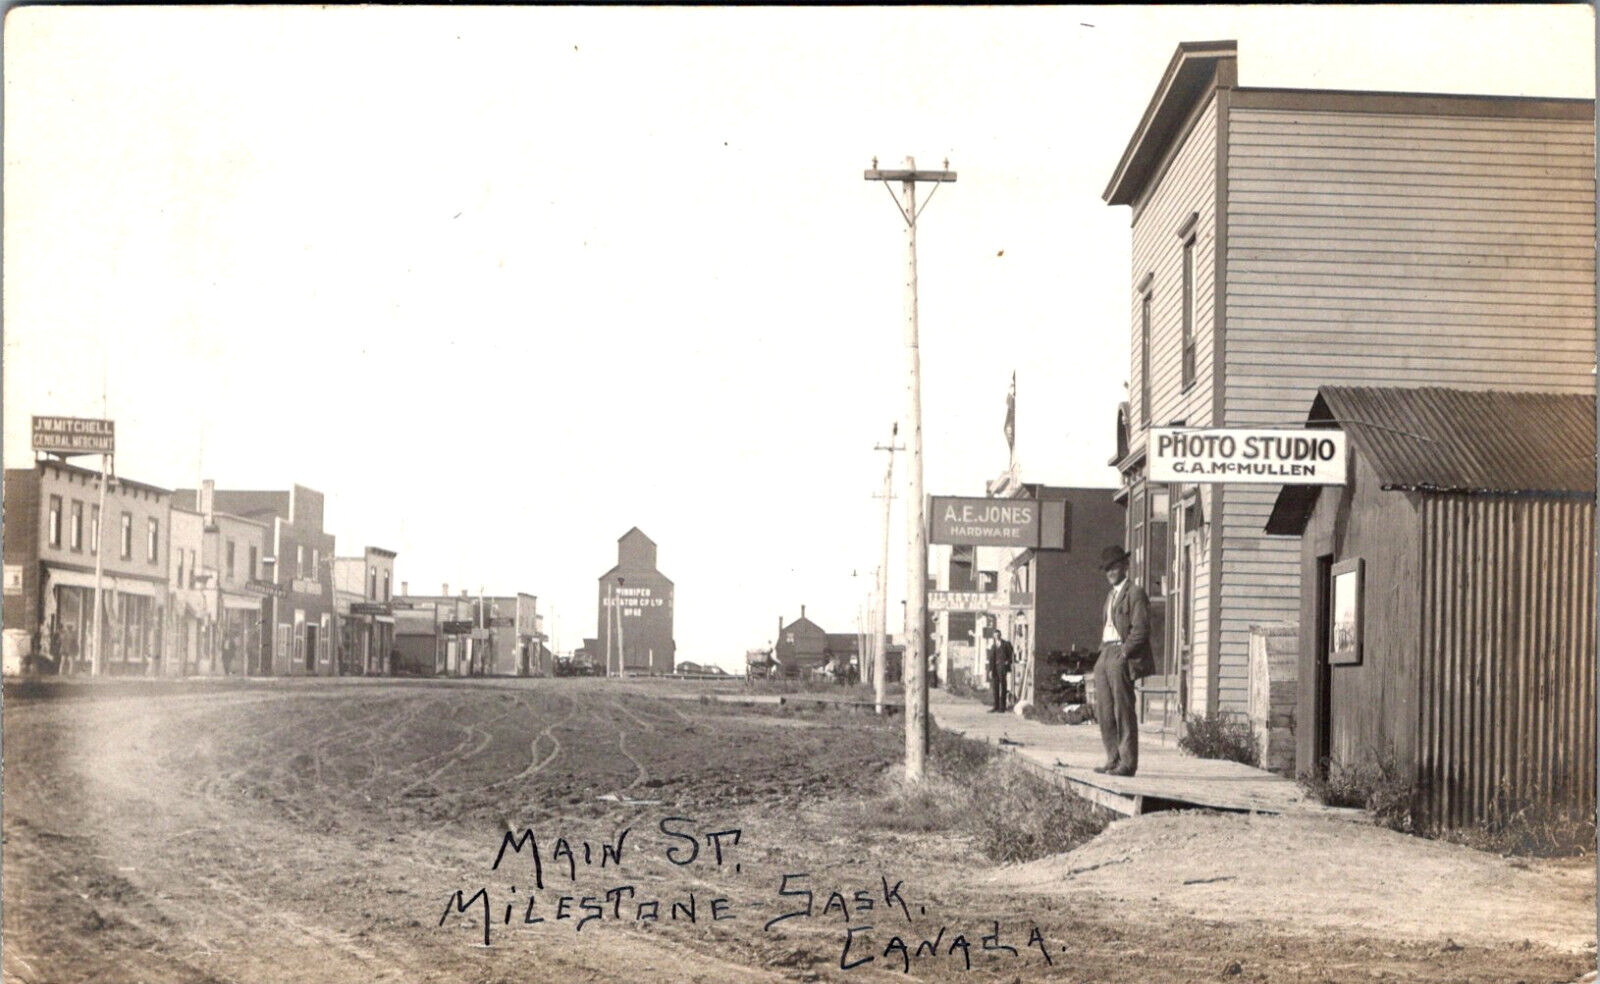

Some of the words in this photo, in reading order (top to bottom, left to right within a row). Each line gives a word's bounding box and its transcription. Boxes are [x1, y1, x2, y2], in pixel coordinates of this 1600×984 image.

[33, 433, 71, 447] GENERAL
[72, 435, 113, 450] MERCHANT
[1157, 434, 1236, 459] PHOTO
[1242, 436, 1336, 461] STUDIO
[950, 526, 1021, 538] HARDWARE
